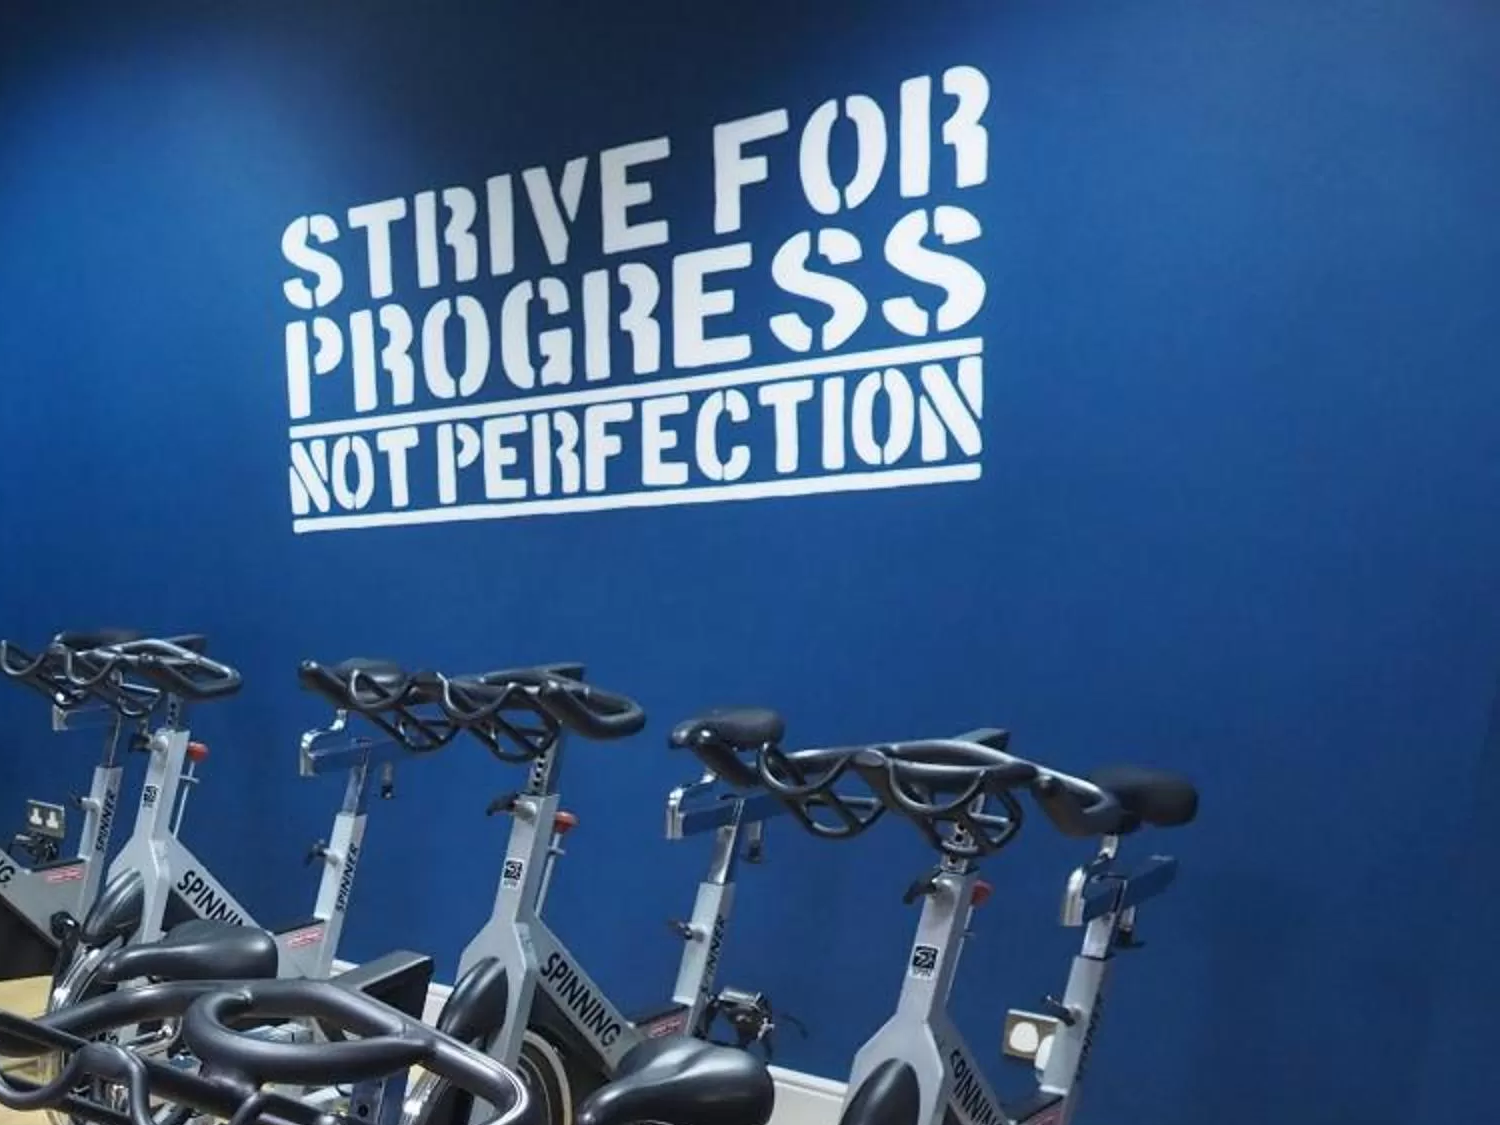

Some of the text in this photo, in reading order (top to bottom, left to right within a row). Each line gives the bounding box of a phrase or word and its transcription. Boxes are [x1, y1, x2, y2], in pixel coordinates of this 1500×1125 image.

[280, 66, 990, 308] STRIVE FOR
[285, 205, 986, 418] PROGRESS
[289, 355, 983, 515] NOT PERFECTION
[177, 869, 245, 927] SPINNI
[539, 952, 621, 1047] SPINNING
